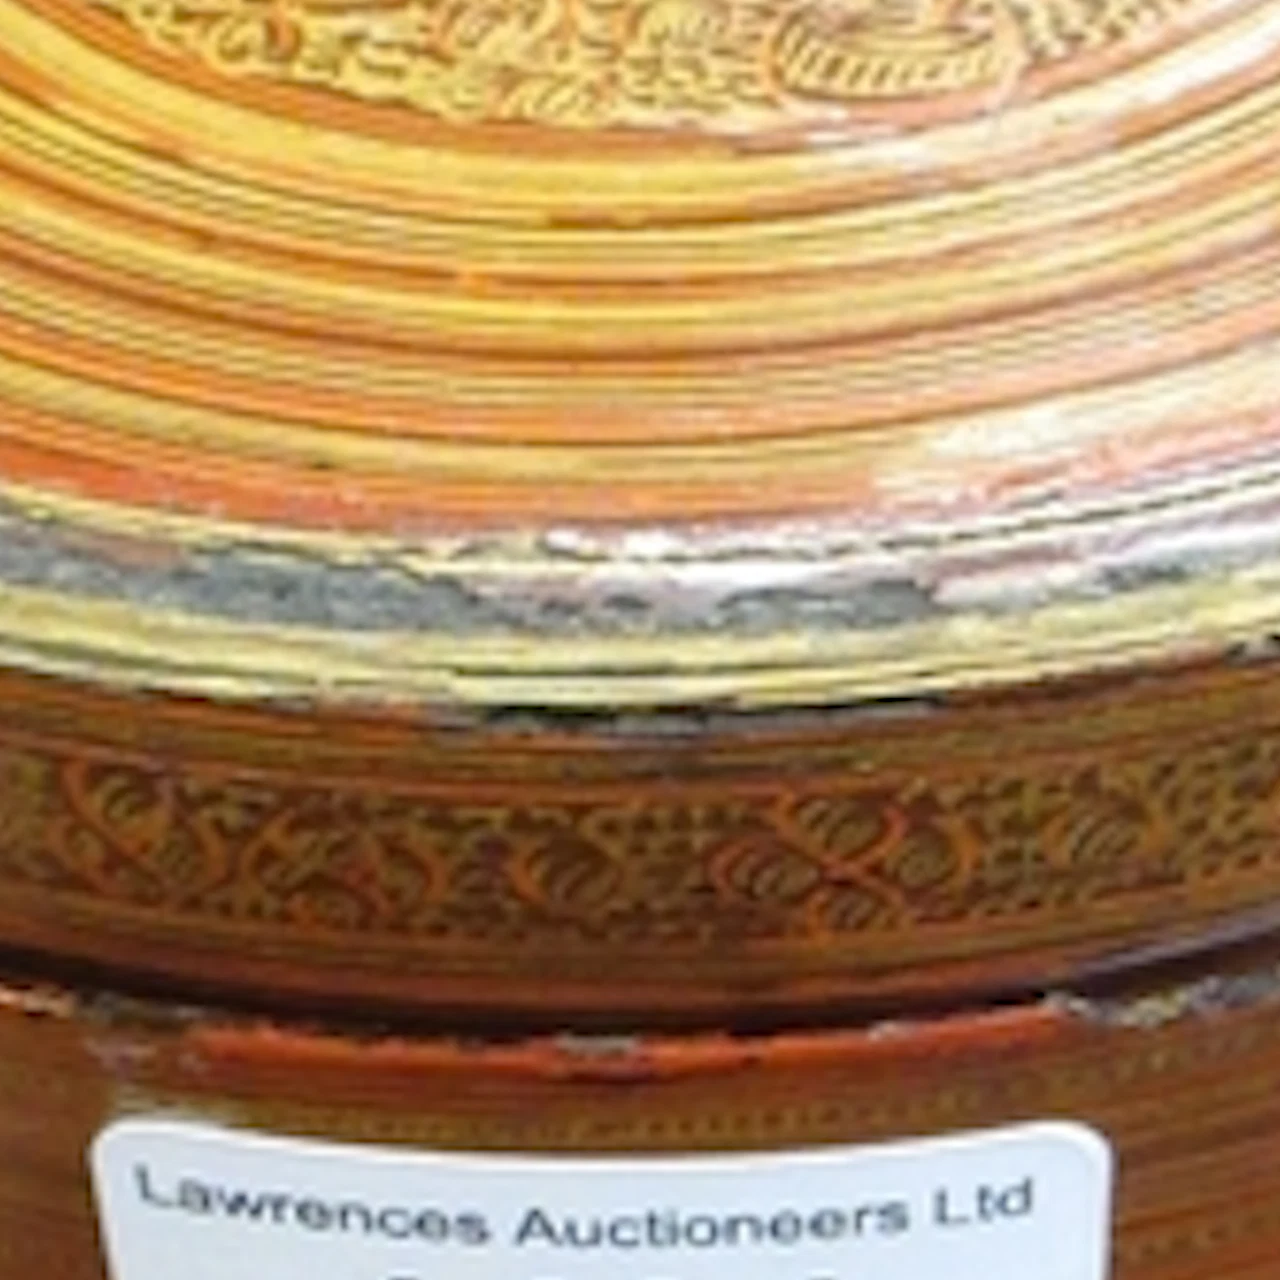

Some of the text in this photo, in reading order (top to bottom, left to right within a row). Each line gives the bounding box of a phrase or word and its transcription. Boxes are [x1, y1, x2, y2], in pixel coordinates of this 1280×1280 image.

[134, 1165, 1035, 1249] Lawrences Auctioneers Ltd
